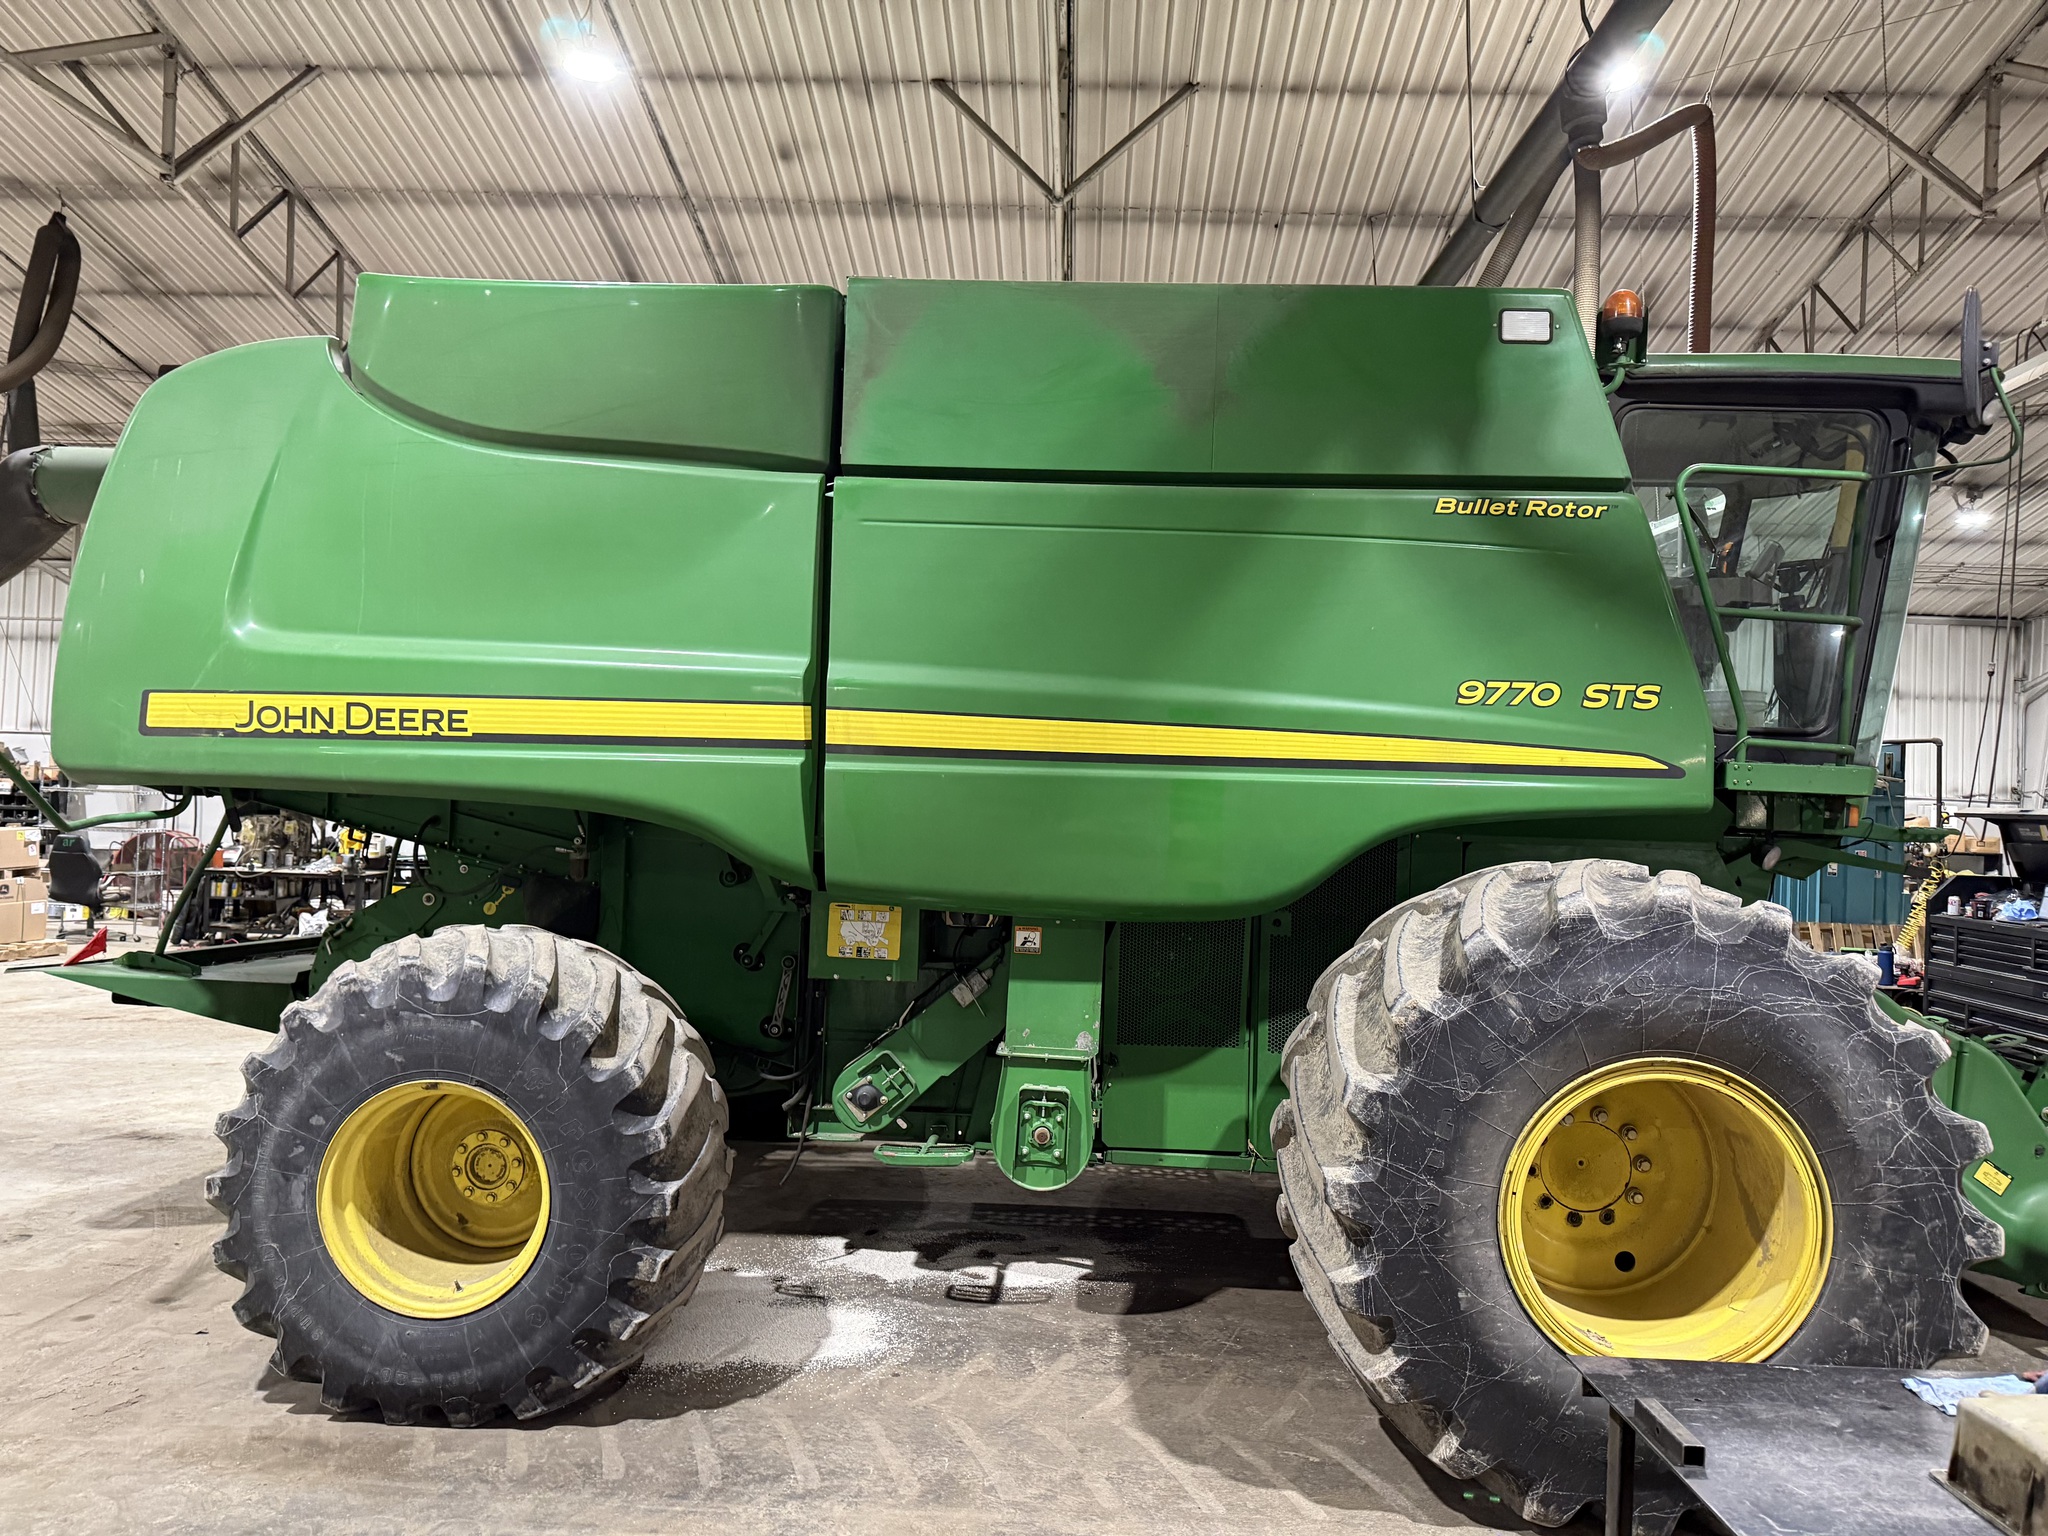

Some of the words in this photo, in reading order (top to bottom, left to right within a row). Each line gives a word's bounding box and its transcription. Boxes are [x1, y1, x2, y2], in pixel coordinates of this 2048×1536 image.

[1434, 497, 1518, 516] Bullet
[1524, 499, 1608, 519] Rotor
[1455, 679, 1562, 707] 9770
[1581, 682, 1662, 710] STS
[236, 700, 334, 729] JOHN
[346, 702, 468, 733] DEERE
[522, 1067, 600, 1329] Firestone
